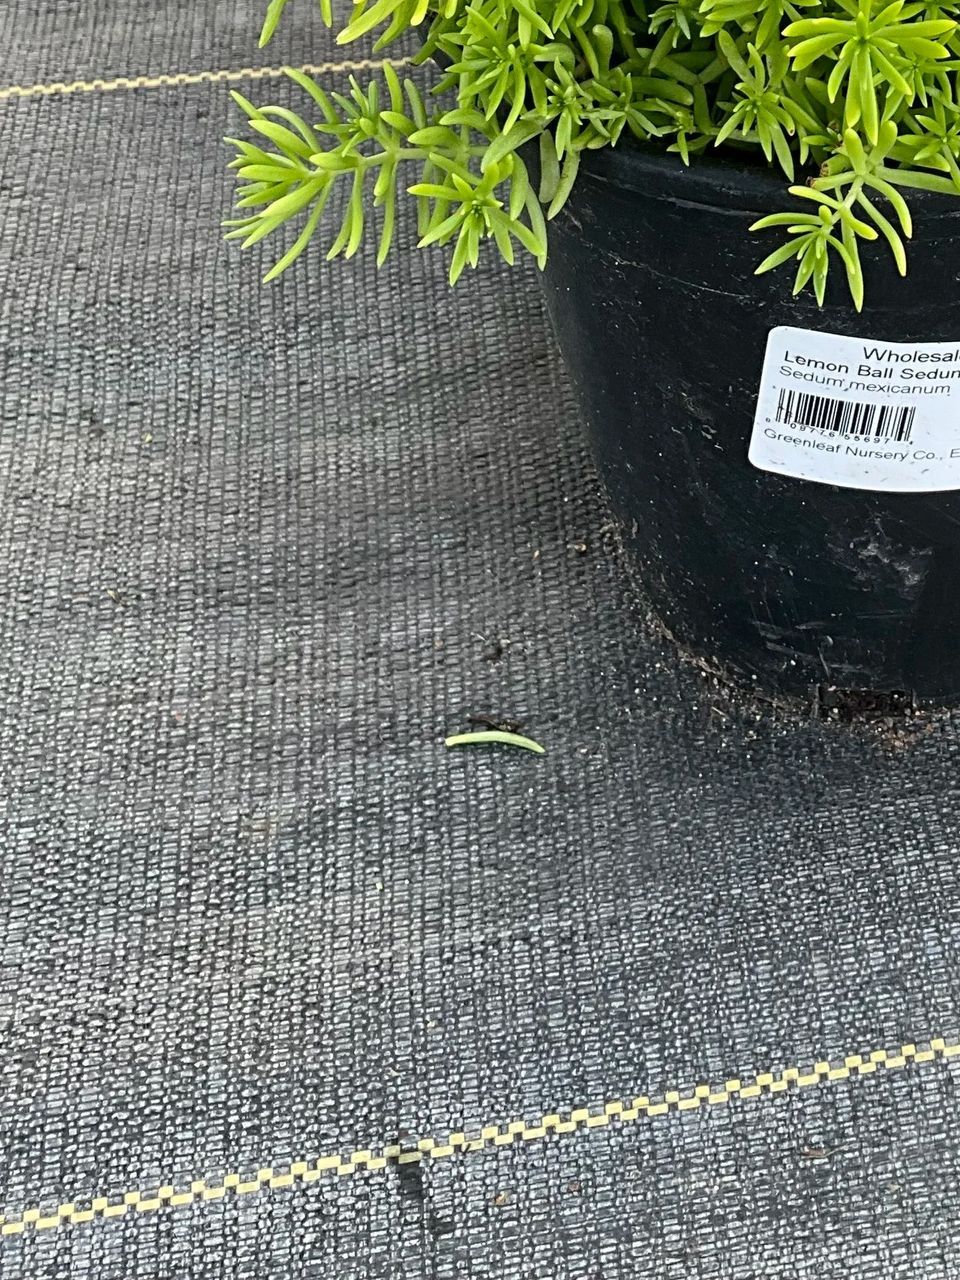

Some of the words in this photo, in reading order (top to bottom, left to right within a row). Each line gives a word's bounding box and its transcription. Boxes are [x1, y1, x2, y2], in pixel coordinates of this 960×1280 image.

[784, 350, 849, 374] Lemon
[857, 364, 893, 379] Ball
[779, 365, 843, 388] Sedum
[849, 379, 950, 395] mexicanum
[764, 428, 841, 453] Greenleaf
[845, 445, 909, 462] Nursery
